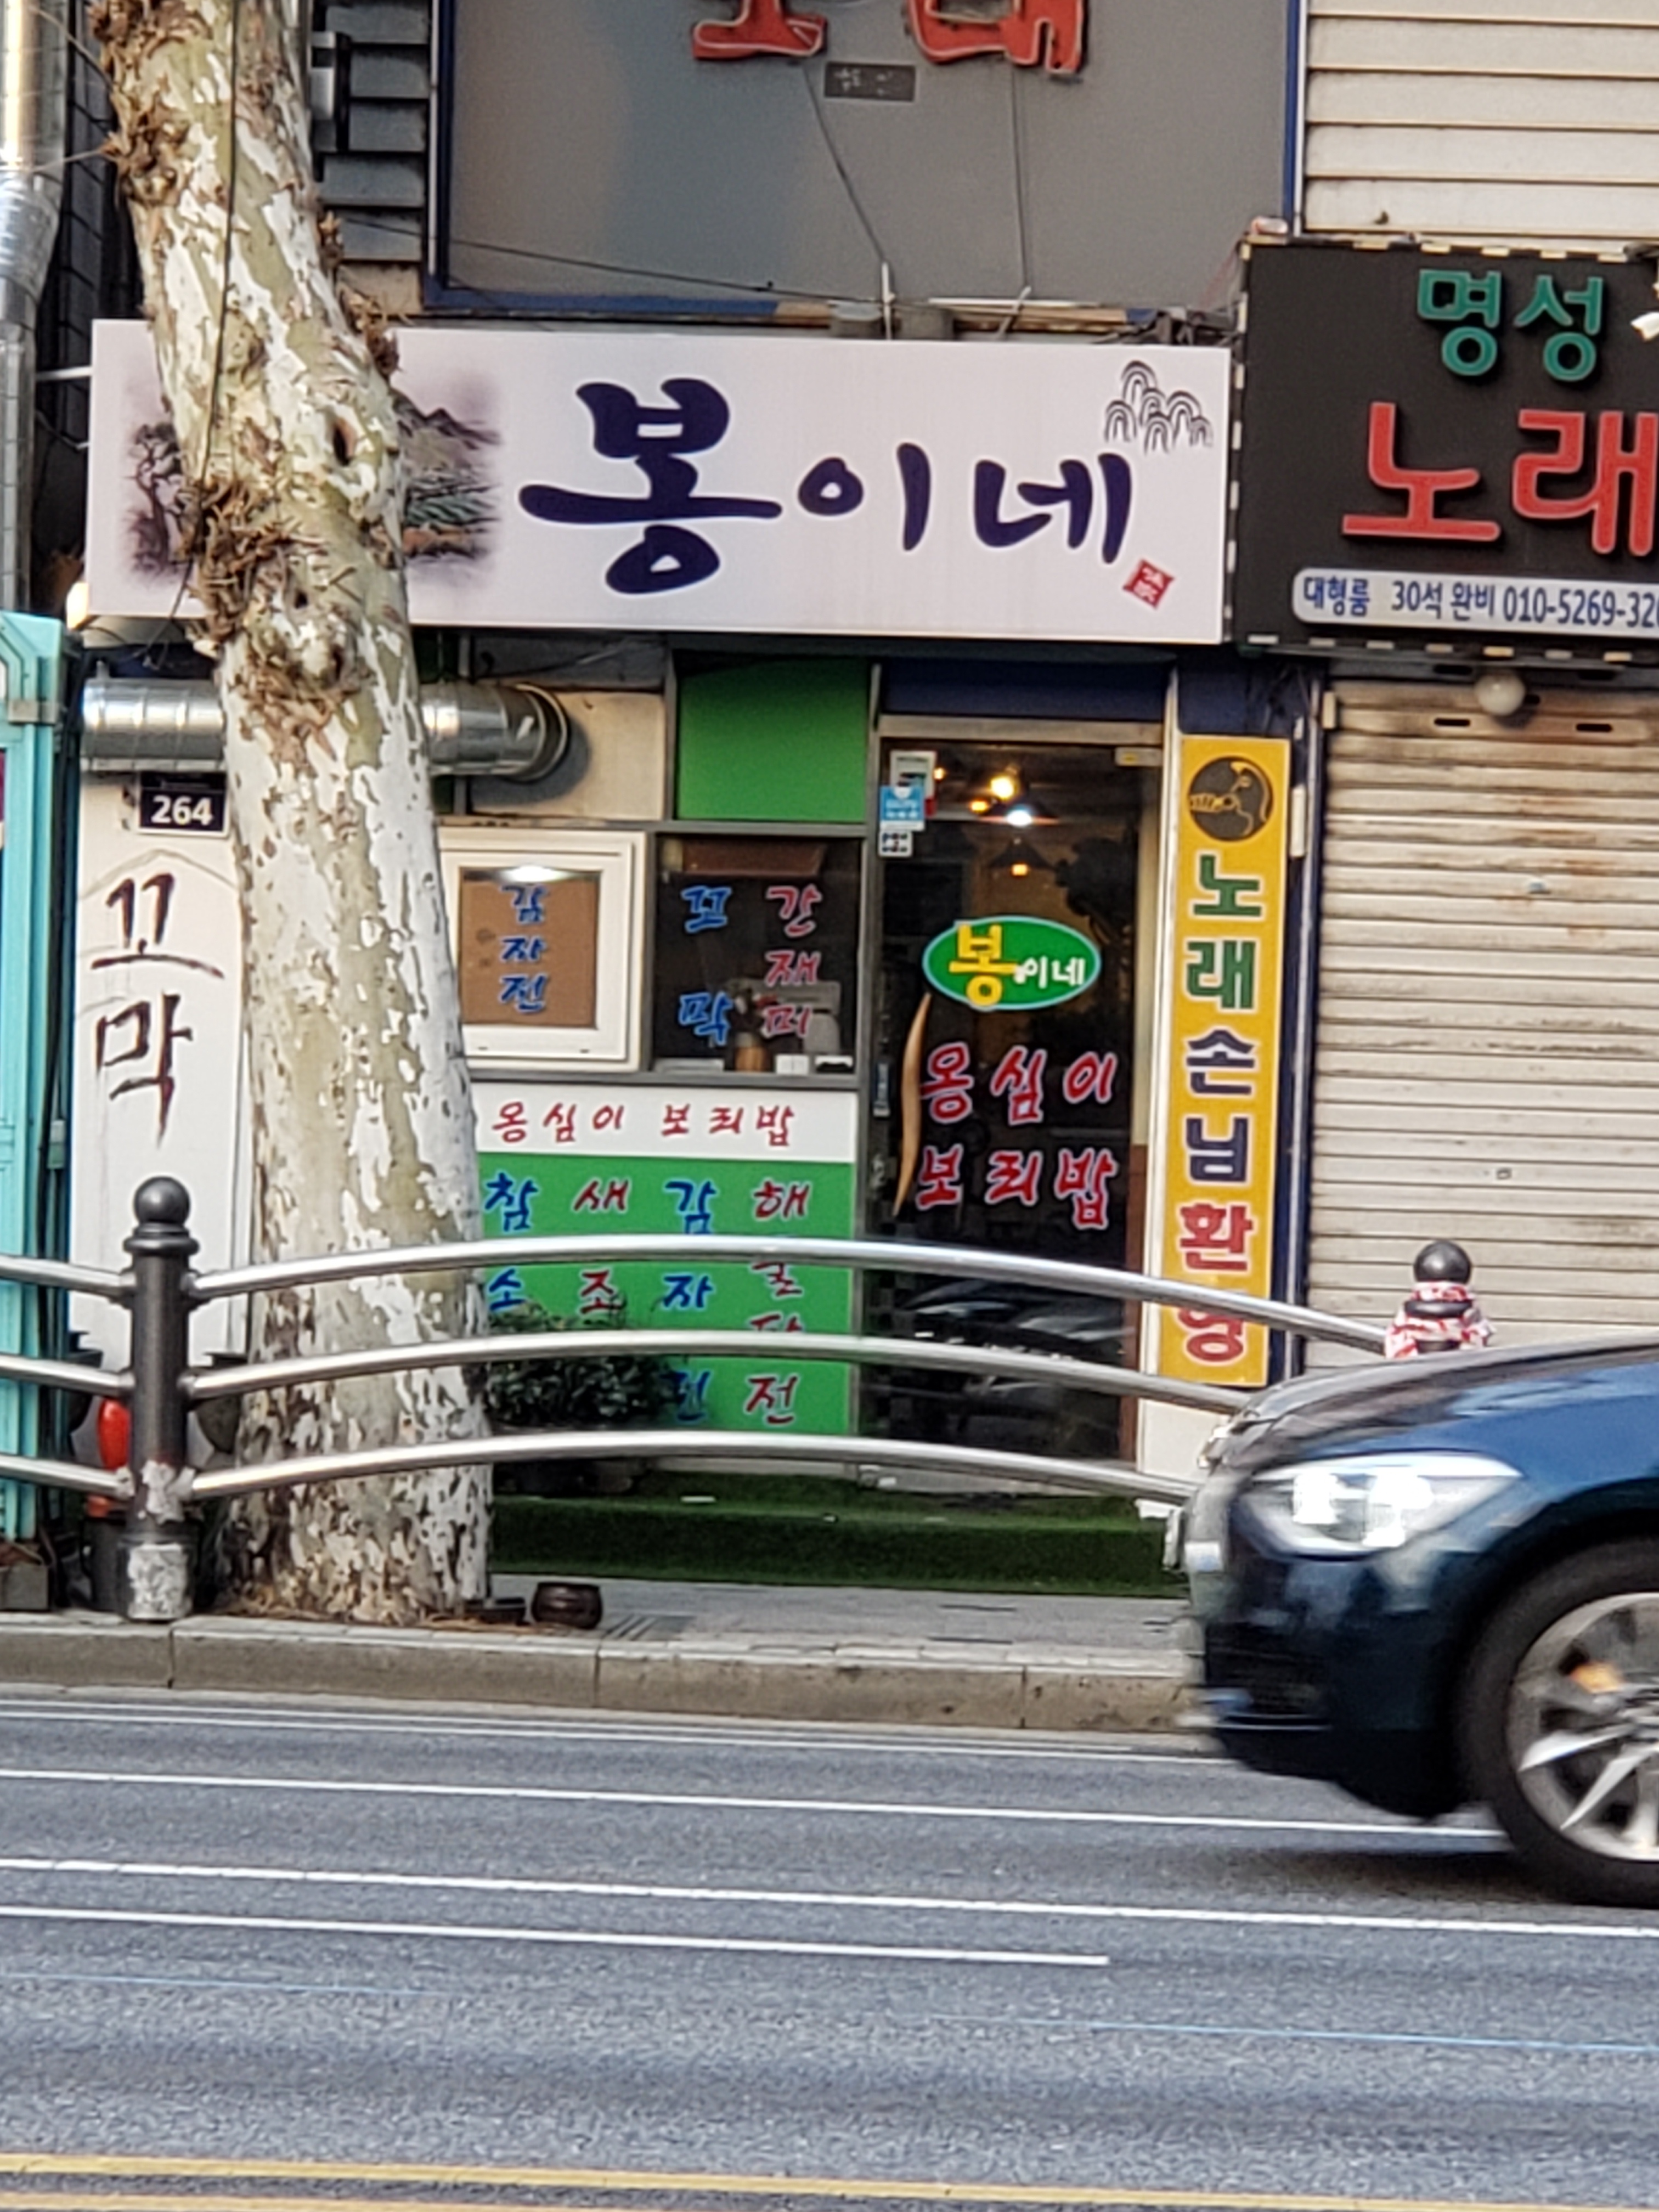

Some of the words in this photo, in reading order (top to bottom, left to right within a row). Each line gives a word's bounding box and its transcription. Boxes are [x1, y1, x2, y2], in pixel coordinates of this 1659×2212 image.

[1417, 269, 1603, 381] 명성
[519, 378, 1132, 594] 봉이네
[1342, 402, 1658, 556] 노래
[1304, 576, 1370, 617] 대형룸
[1391, 580, 1443, 620] 30석
[1451, 582, 1495, 621] 완비
[1503, 585, 1659, 628] 010-5269-32
[151, 794, 215, 826] 264
[949, 924, 1085, 1006] 봉이네
[91, 873, 224, 1149] 꼬막
[493, 1101, 625, 1143] 옹심이
[662, 1103, 794, 1147] 보리밥
[920, 1042, 1117, 1126] 옹심이
[915, 1143, 1118, 1229] 보리밥
